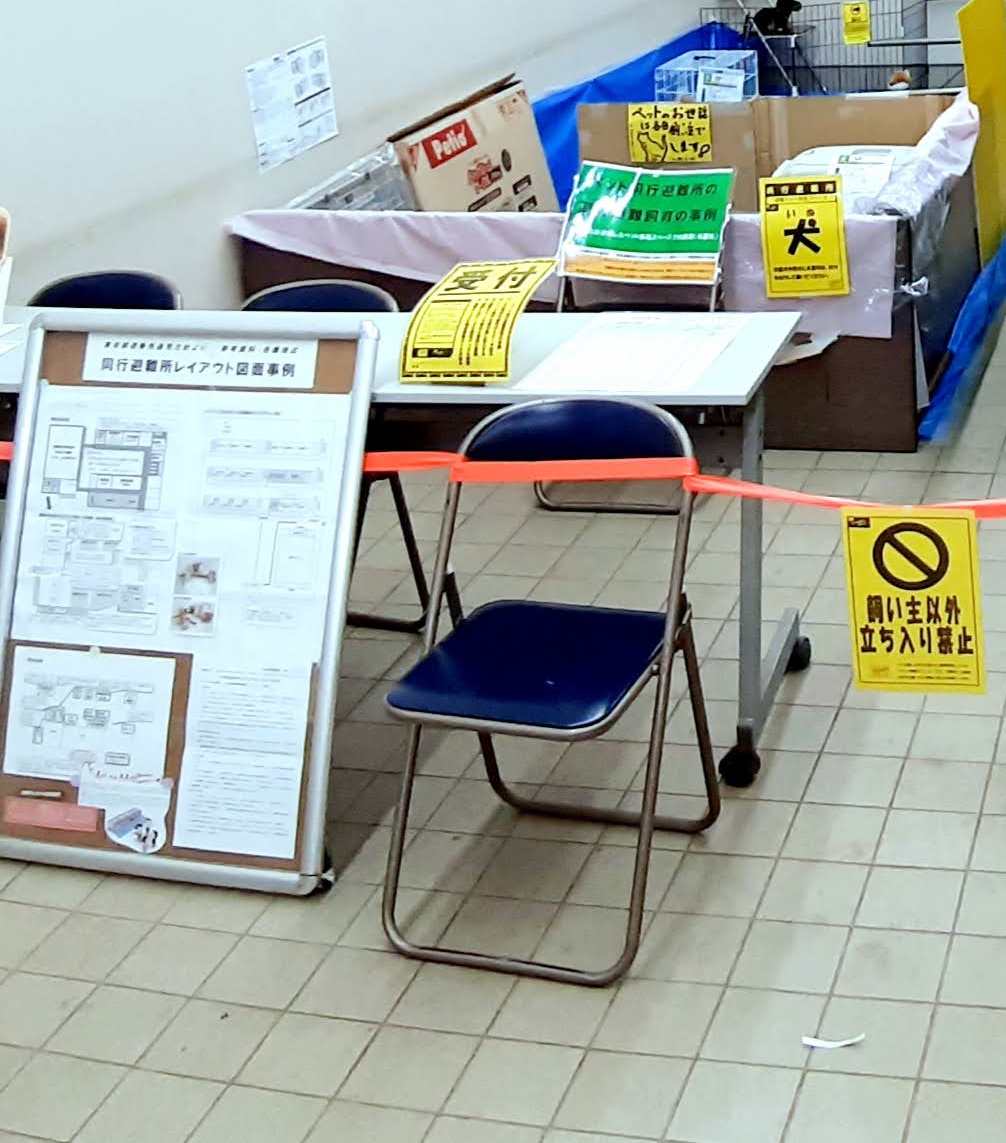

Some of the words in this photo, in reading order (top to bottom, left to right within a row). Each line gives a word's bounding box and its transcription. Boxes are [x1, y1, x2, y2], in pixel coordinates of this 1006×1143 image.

[783, 218, 822, 256] 犬
[444, 265, 538, 292] 受付
[101, 357, 296, 377] 同行避難所レイアウト図面事例
[866, 594, 961, 625] 飼い主以外
[859, 624, 974, 655] 立ち入り禁止
